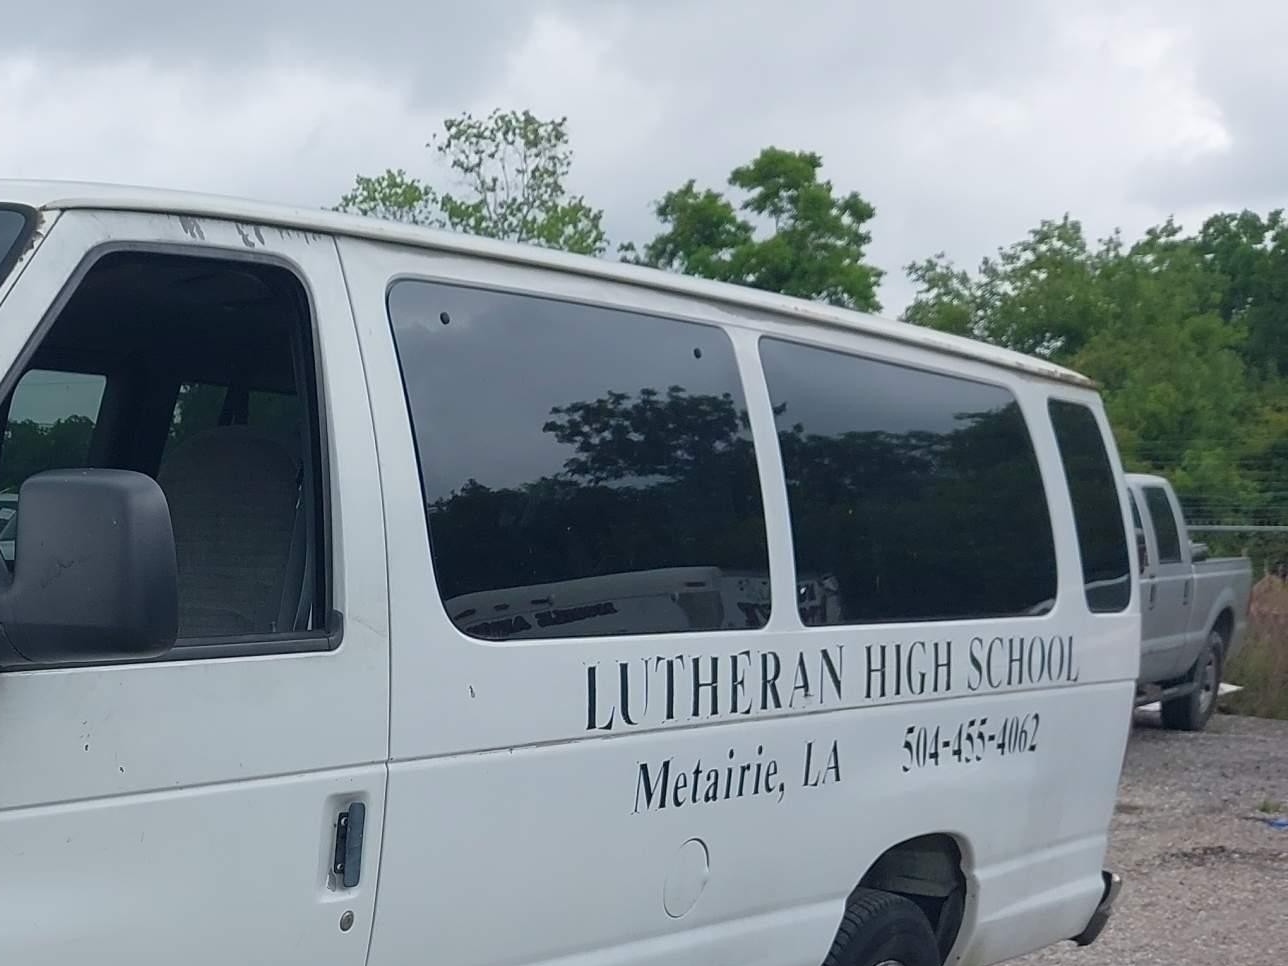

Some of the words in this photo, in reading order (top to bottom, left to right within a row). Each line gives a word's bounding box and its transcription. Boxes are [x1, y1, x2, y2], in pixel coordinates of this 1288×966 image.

[582, 644, 845, 731] LUTHERAN
[863, 640, 953, 699] HIGH
[967, 634, 1081, 692] SCHOOL
[630, 744, 786, 816] Metairie,
[802, 738, 842, 787] LA
[901, 712, 1041, 774] 504-455-4062
